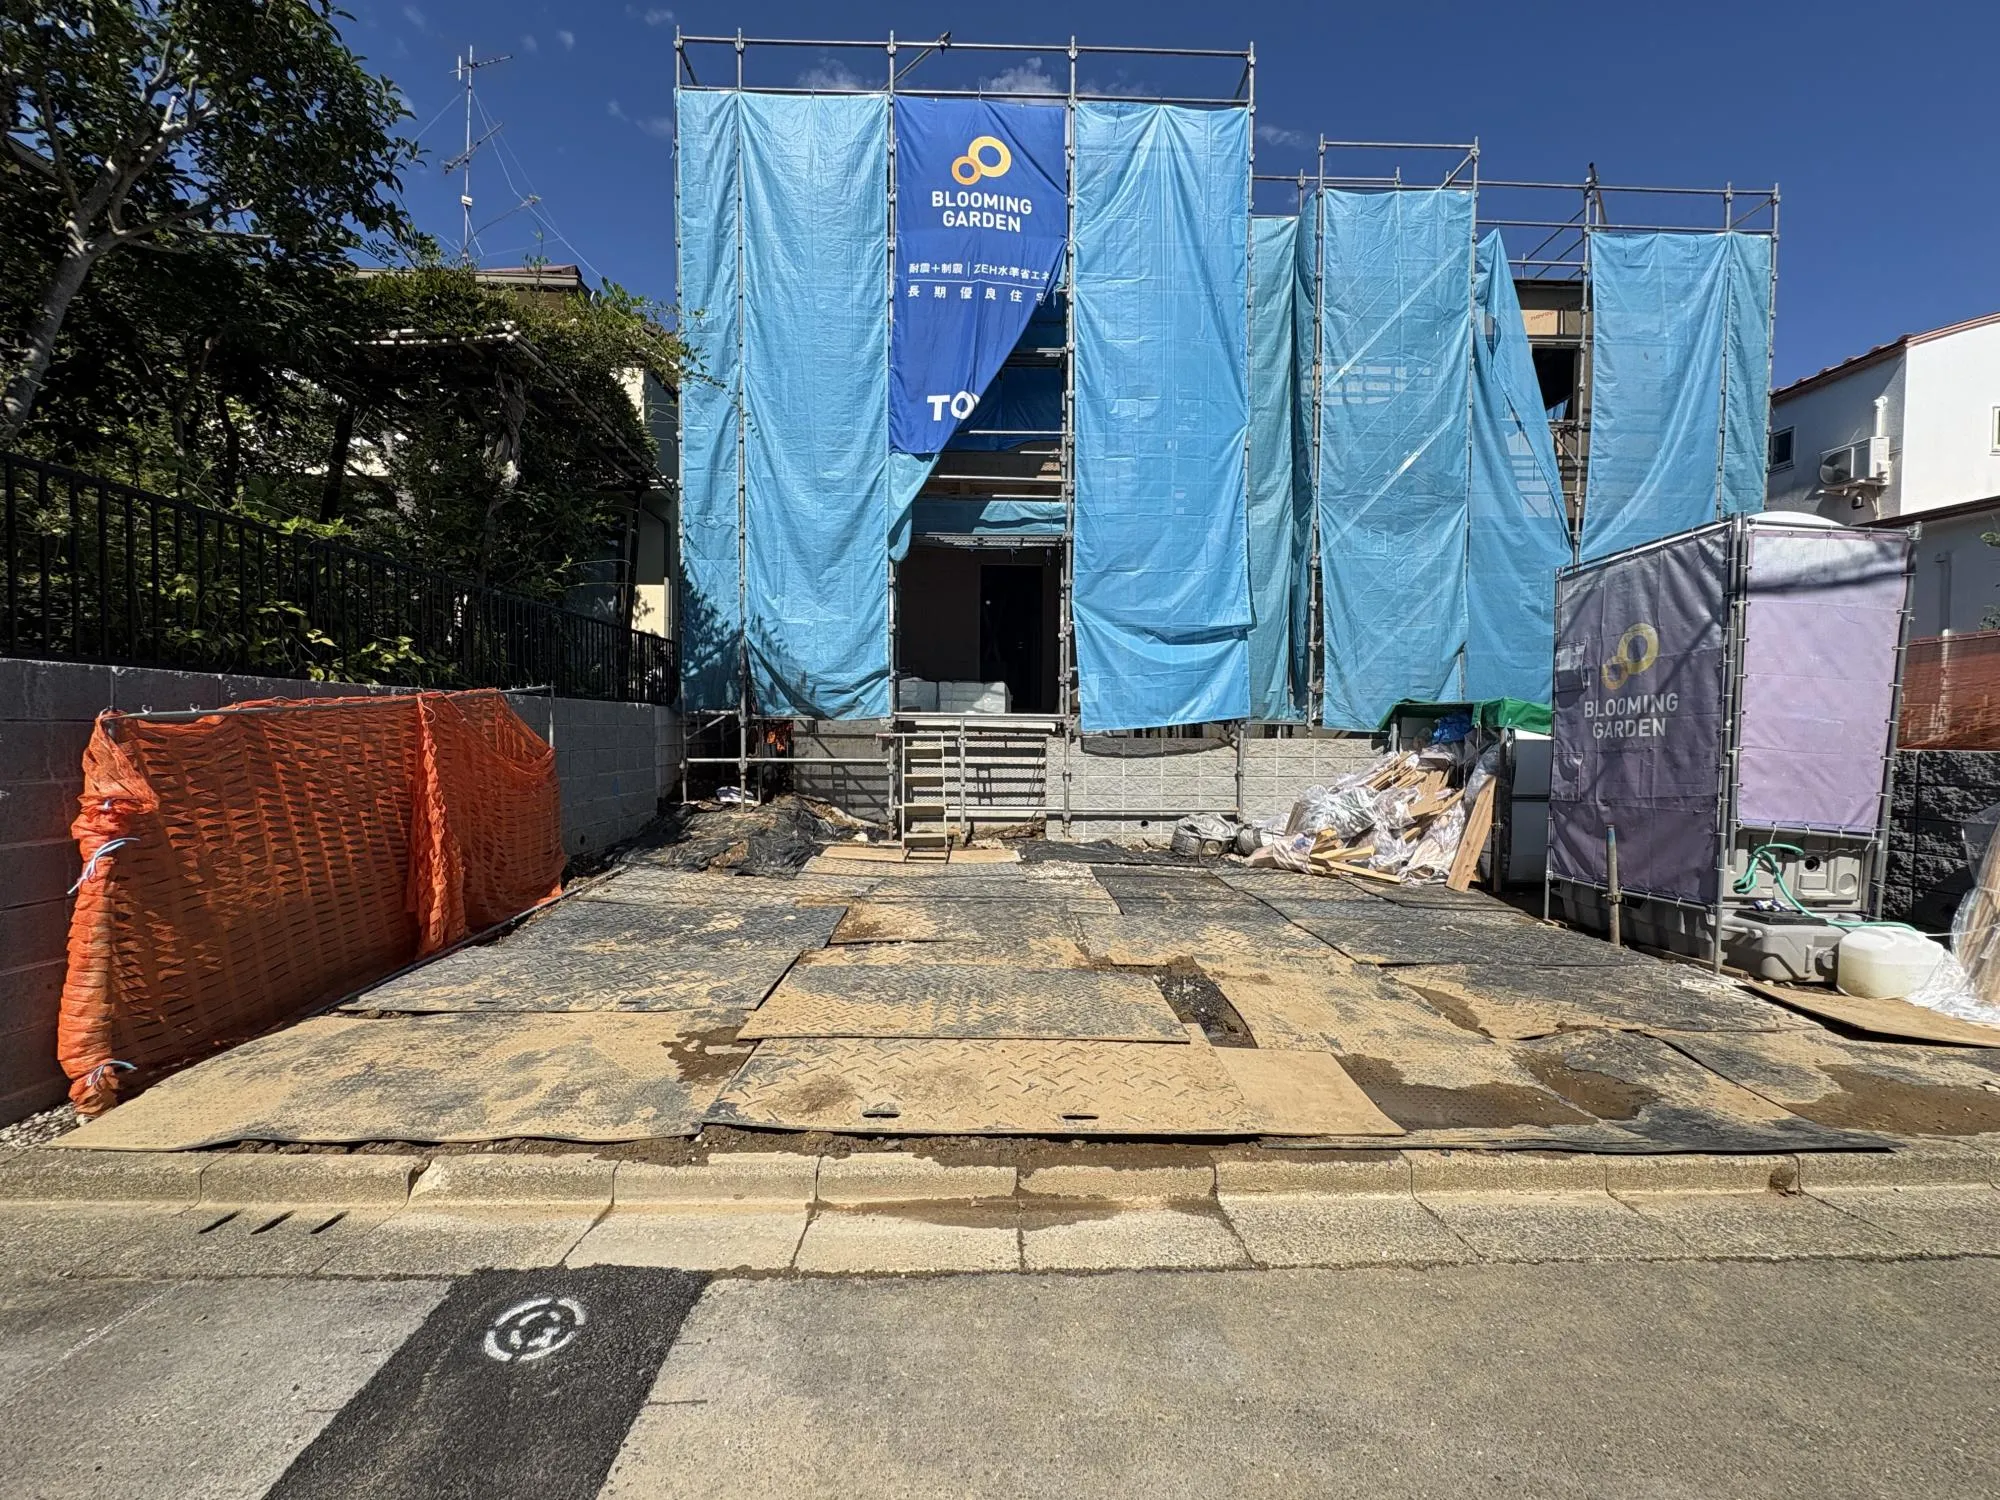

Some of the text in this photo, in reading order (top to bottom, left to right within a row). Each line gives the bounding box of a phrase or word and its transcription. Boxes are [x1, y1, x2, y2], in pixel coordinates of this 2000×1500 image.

[931, 191, 1033, 215] BLOOMING
[942, 211, 1021, 232] GARDEN
[926, 390, 981, 422] TO
[1584, 692, 1679, 719] BLOOMING
[1592, 718, 1667, 739] GARDEN
